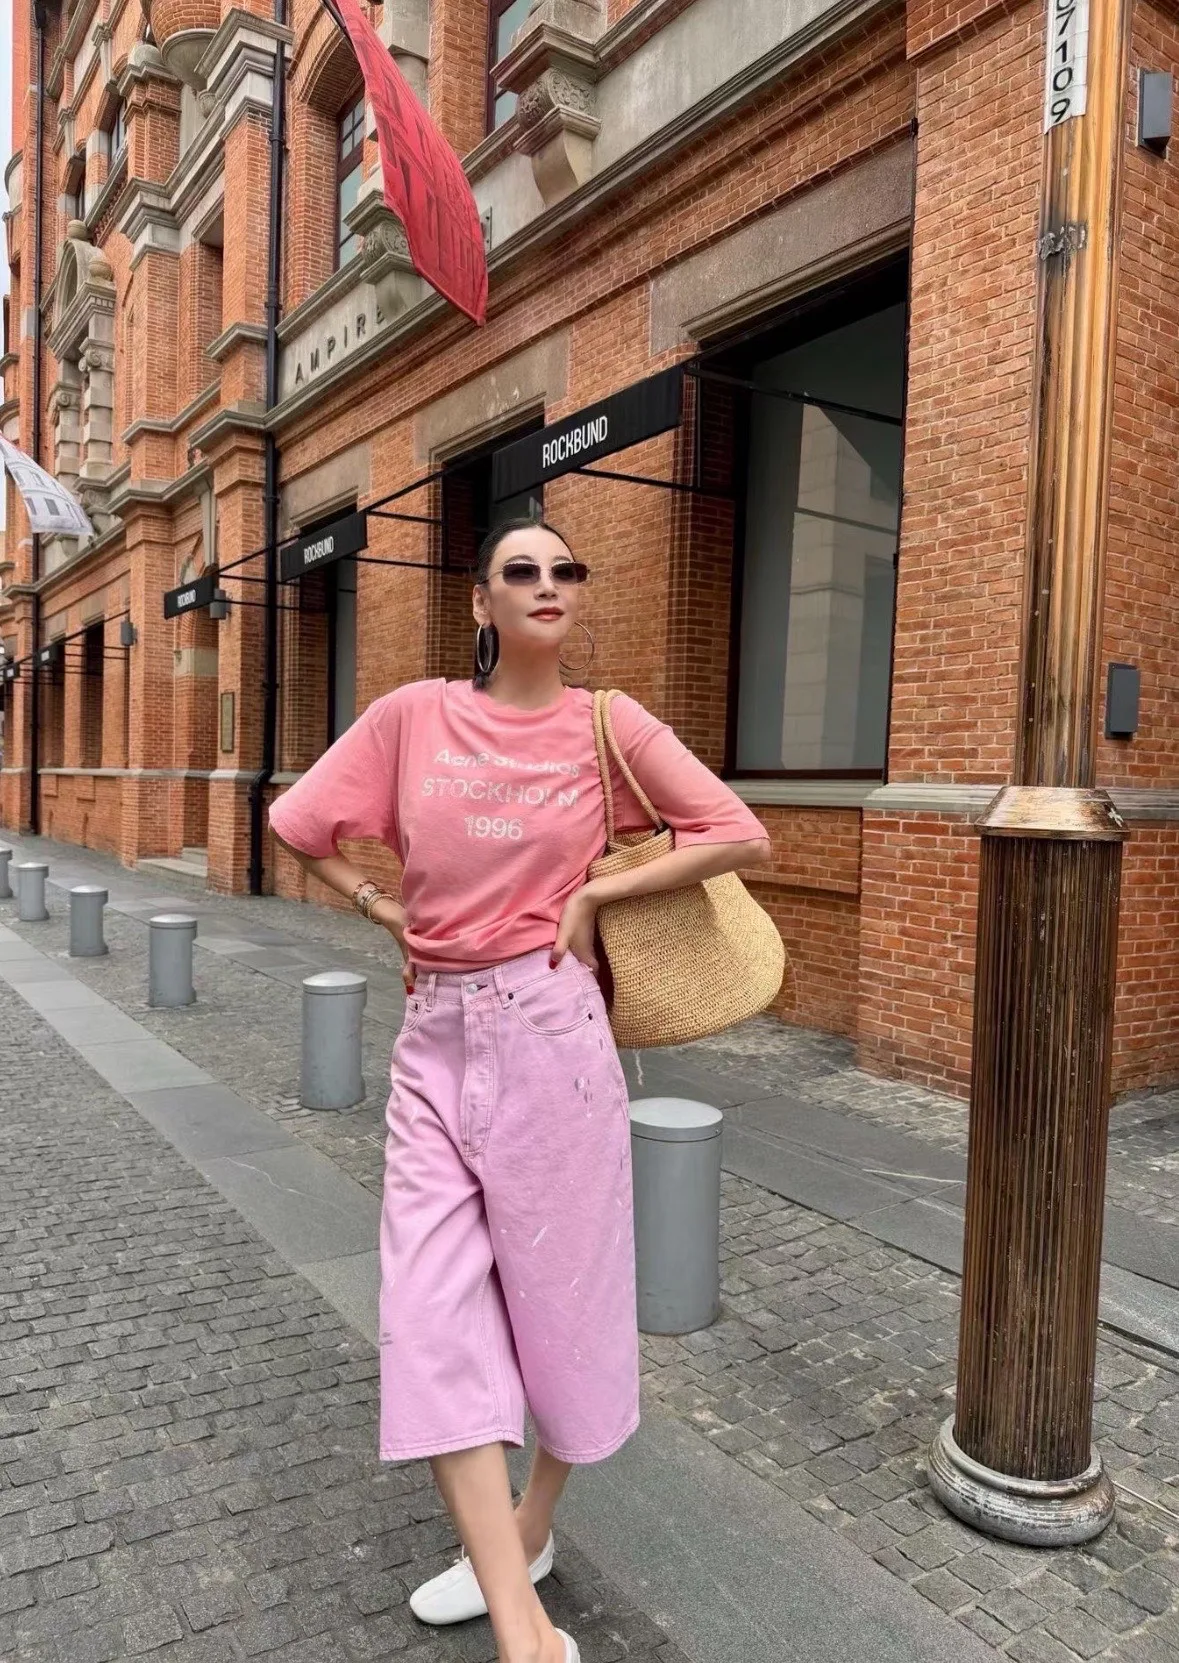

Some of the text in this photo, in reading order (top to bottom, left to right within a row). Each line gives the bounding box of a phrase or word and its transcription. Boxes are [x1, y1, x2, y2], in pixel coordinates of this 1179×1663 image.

[542, 415, 608, 469] ROCKBUND
[303, 535, 335, 565] ROCKBUND
[433, 749, 490, 768] Acne
[421, 777, 579, 807] STOCKHOLM
[464, 815, 524, 840] 1996
